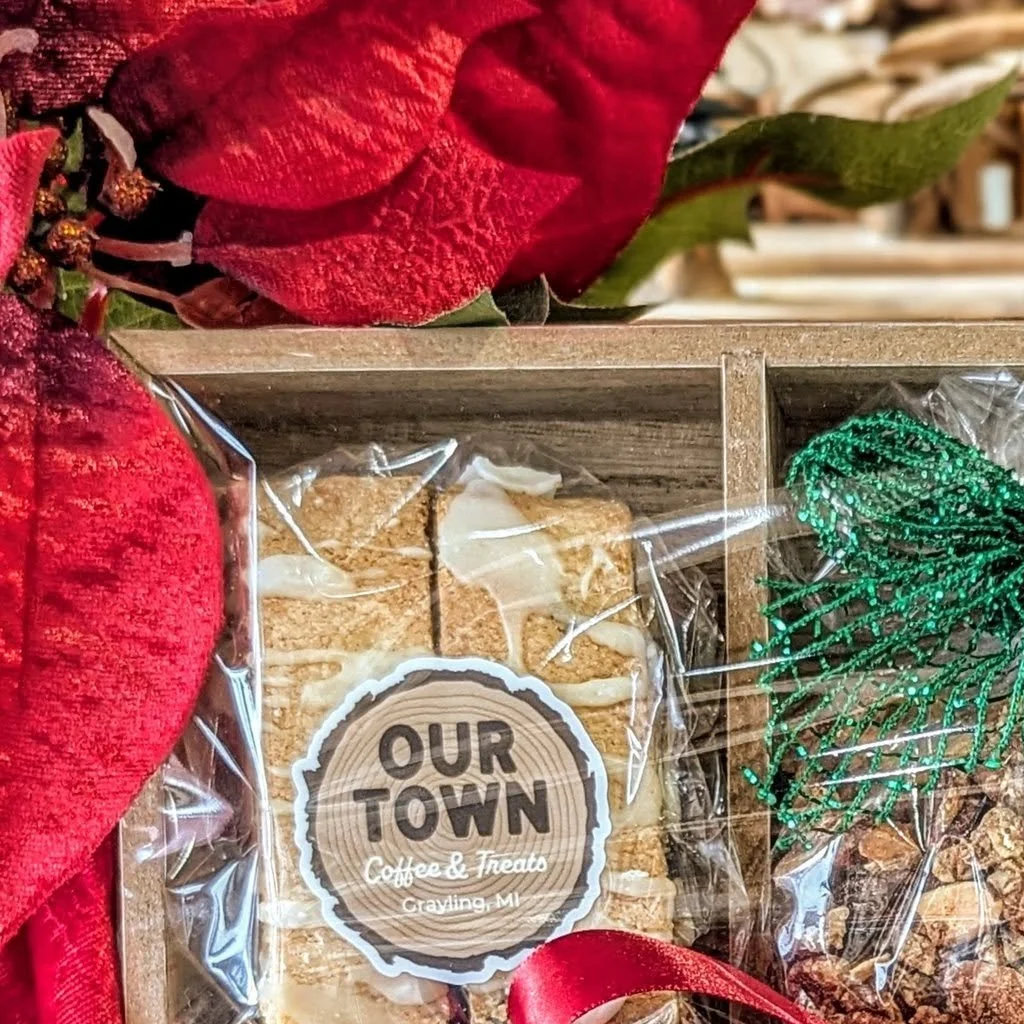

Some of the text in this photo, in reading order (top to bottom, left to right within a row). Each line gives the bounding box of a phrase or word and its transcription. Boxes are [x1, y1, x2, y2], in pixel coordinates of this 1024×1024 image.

[379, 720, 518, 780] OUR
[352, 779, 551, 842] TOWN
[364, 850, 548, 888] Coffee & Treats
[402, 893, 520, 915] Grayling, MI
